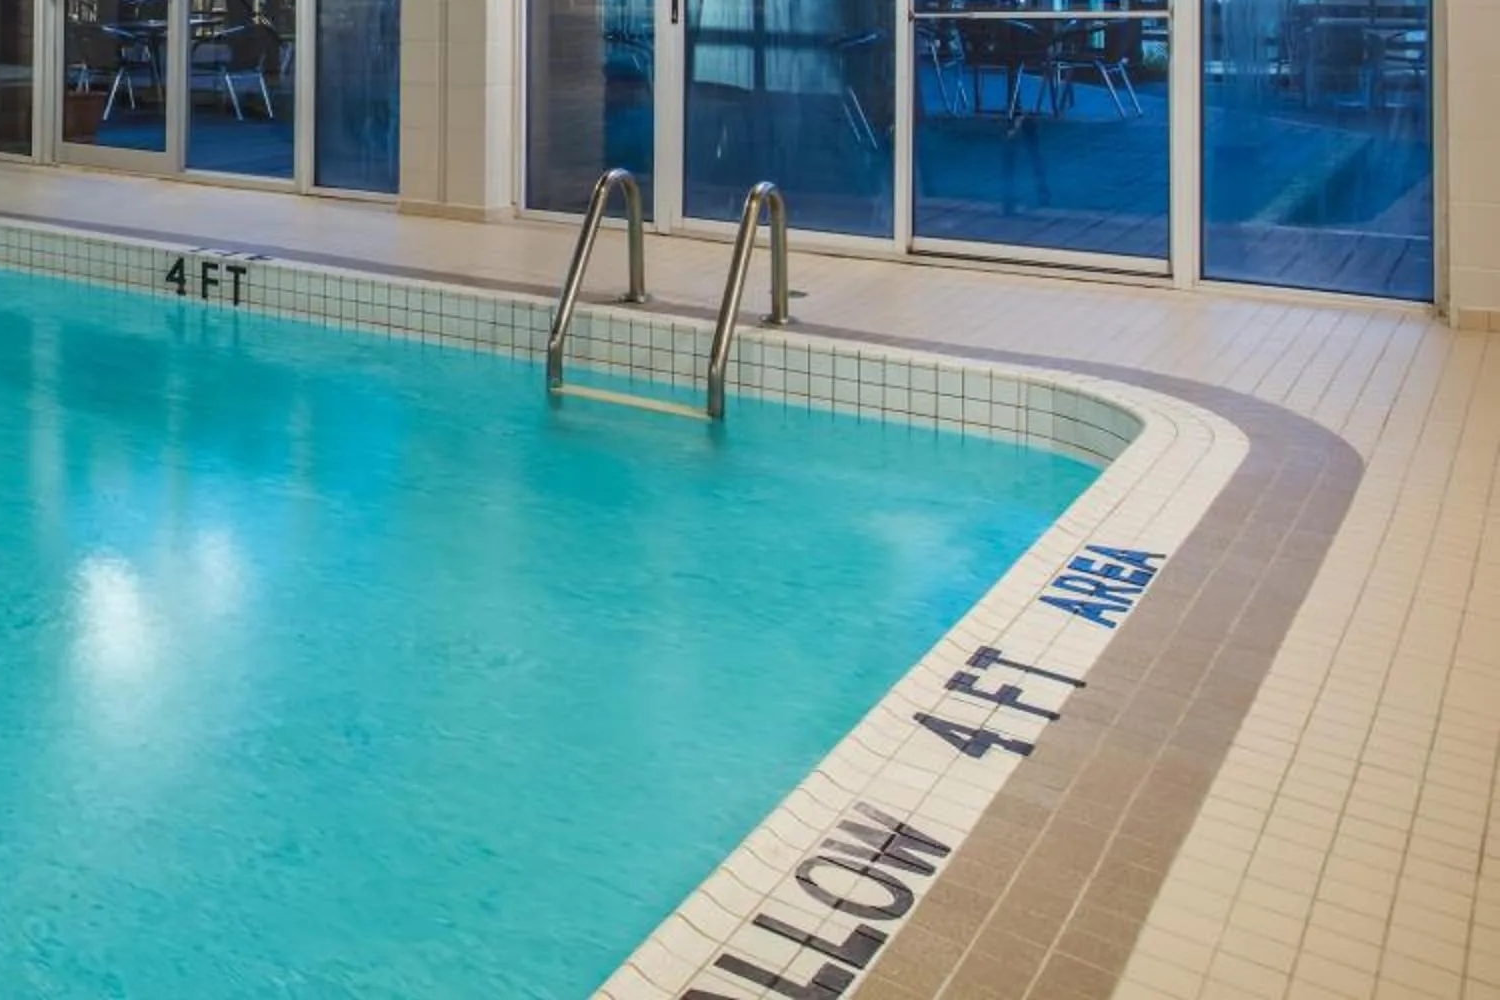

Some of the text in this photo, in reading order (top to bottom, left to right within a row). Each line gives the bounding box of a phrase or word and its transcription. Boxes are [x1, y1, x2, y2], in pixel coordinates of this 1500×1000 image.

[165, 256, 247, 307] 4 FT
[1038, 544, 1167, 629] AREA
[912, 645, 1087, 759] 4 FT
[678, 801, 952, 1000] LLOW
